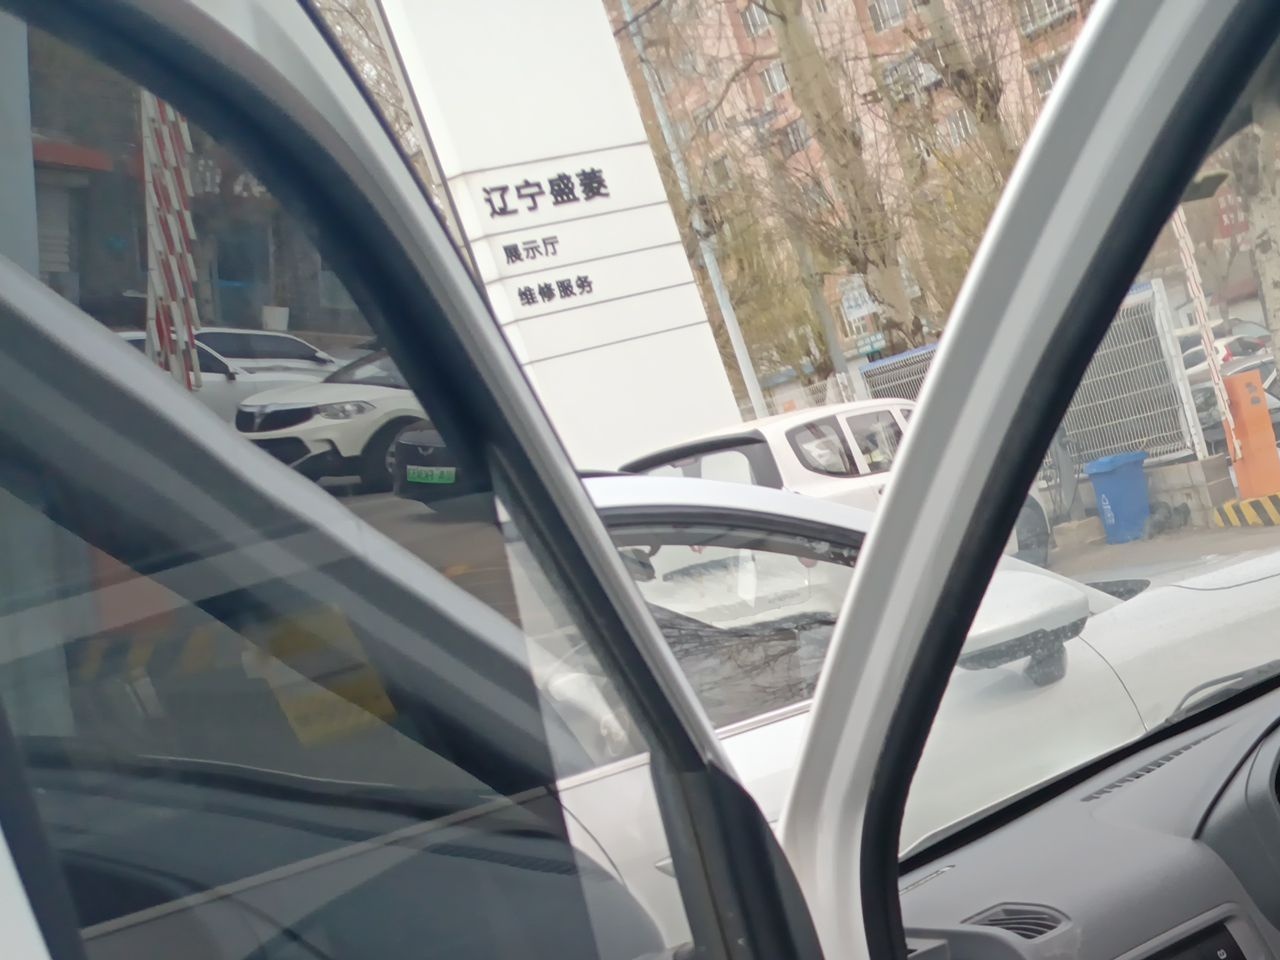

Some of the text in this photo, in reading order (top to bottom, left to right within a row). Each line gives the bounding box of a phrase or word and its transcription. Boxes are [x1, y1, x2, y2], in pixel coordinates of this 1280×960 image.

[482, 167, 610, 219] 辽宁盛菱
[503, 235, 560, 265] 展示厅
[517, 275, 594, 307] 维修服务
